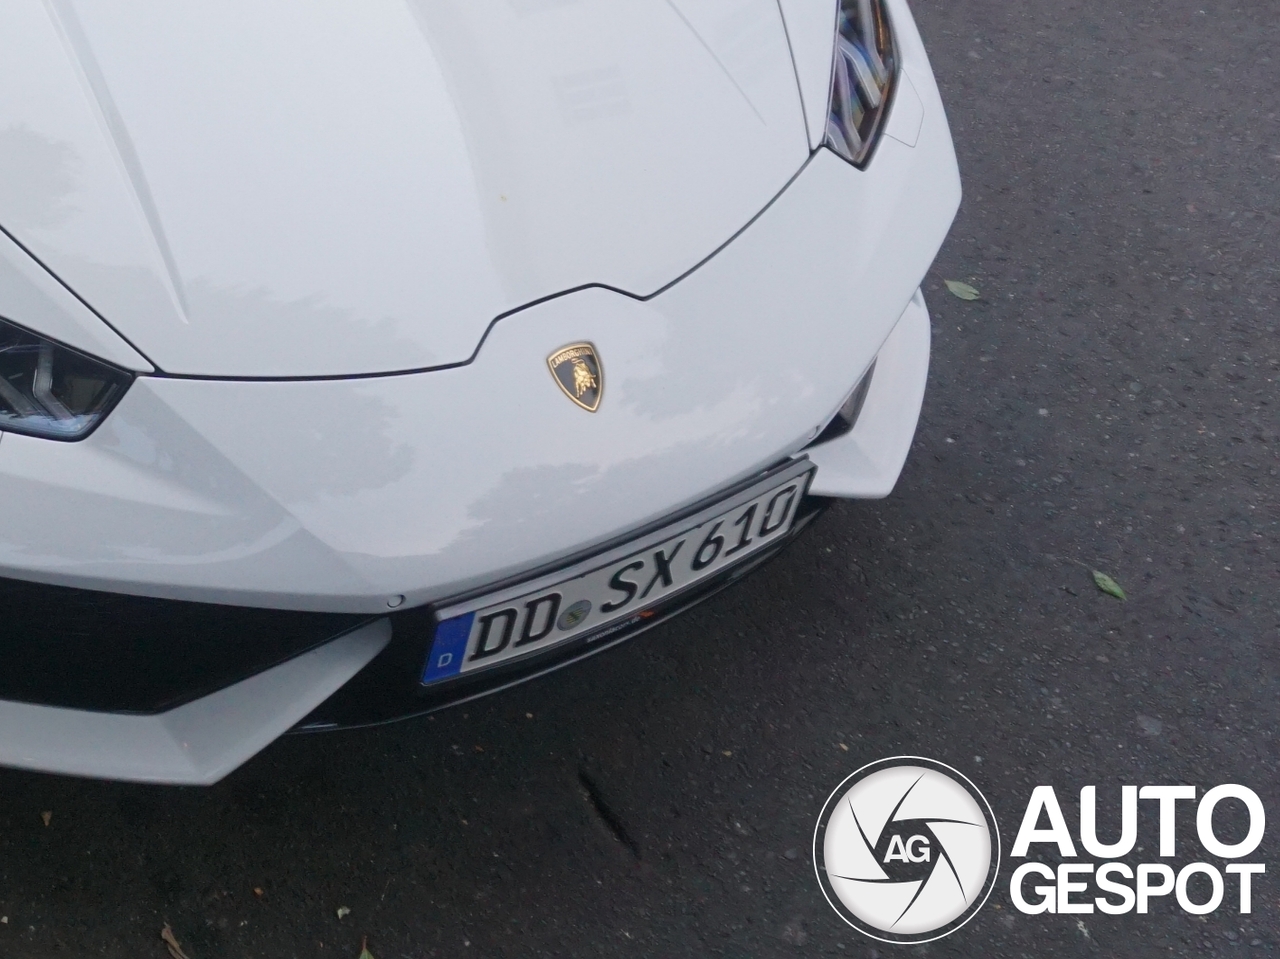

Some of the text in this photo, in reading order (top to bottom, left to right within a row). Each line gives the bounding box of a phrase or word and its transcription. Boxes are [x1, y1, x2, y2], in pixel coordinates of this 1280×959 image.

[551, 347, 593, 368] LAMBORGHINI
[469, 483, 798, 662] DD SX 610
[437, 652, 453, 668] D
